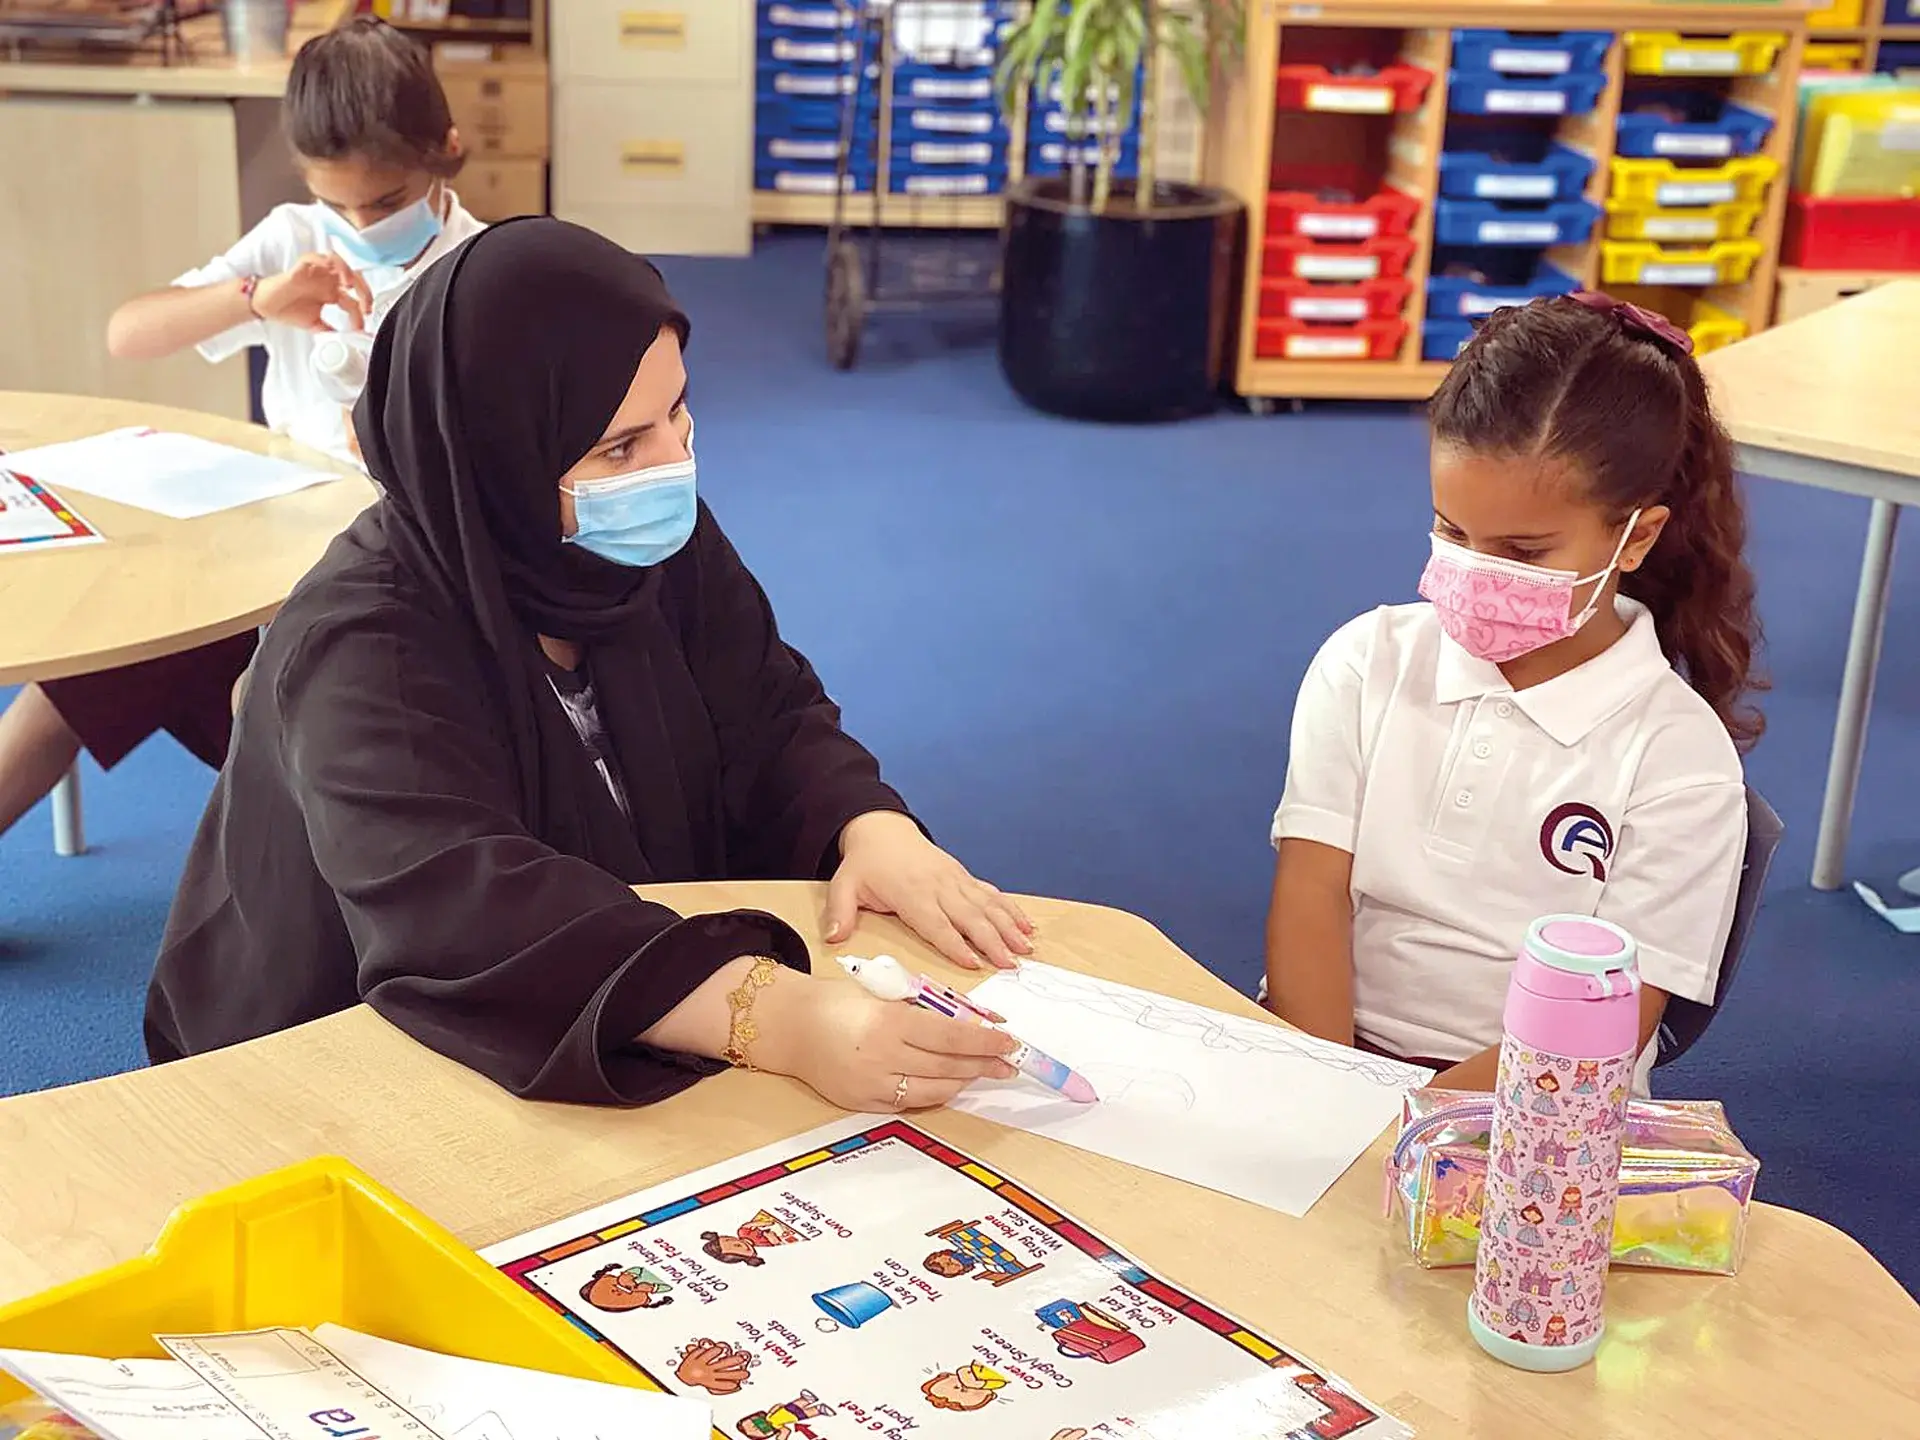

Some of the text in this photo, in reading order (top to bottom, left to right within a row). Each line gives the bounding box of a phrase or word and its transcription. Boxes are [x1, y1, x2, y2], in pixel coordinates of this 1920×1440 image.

[774, 1206, 823, 1239] Use Your
[780, 1191, 853, 1239] Own Supplies
[984, 1215, 1048, 1258] Stay Home
[1001, 1208, 1063, 1251] When Sick
[627, 1240, 718, 1305] Keep Your Hands
[653, 1238, 729, 1292] Off Your Face
[884, 1258, 942, 1302] Trash Can
[873, 1271, 918, 1305] Use the
[1110, 1284, 1179, 1326] Your Food
[1098, 1295, 1156, 1330] Only Eat
[736, 1320, 798, 1368] Wash Your
[767, 1319, 806, 1350] Hands
[972, 1344, 1044, 1390] Cover Your
[980, 1327, 1074, 1389] Cough/Sneeze
[838, 1400, 873, 1424] Feet
[867, 1421, 884, 1431] 6
[873, 1404, 920, 1430] Apart
